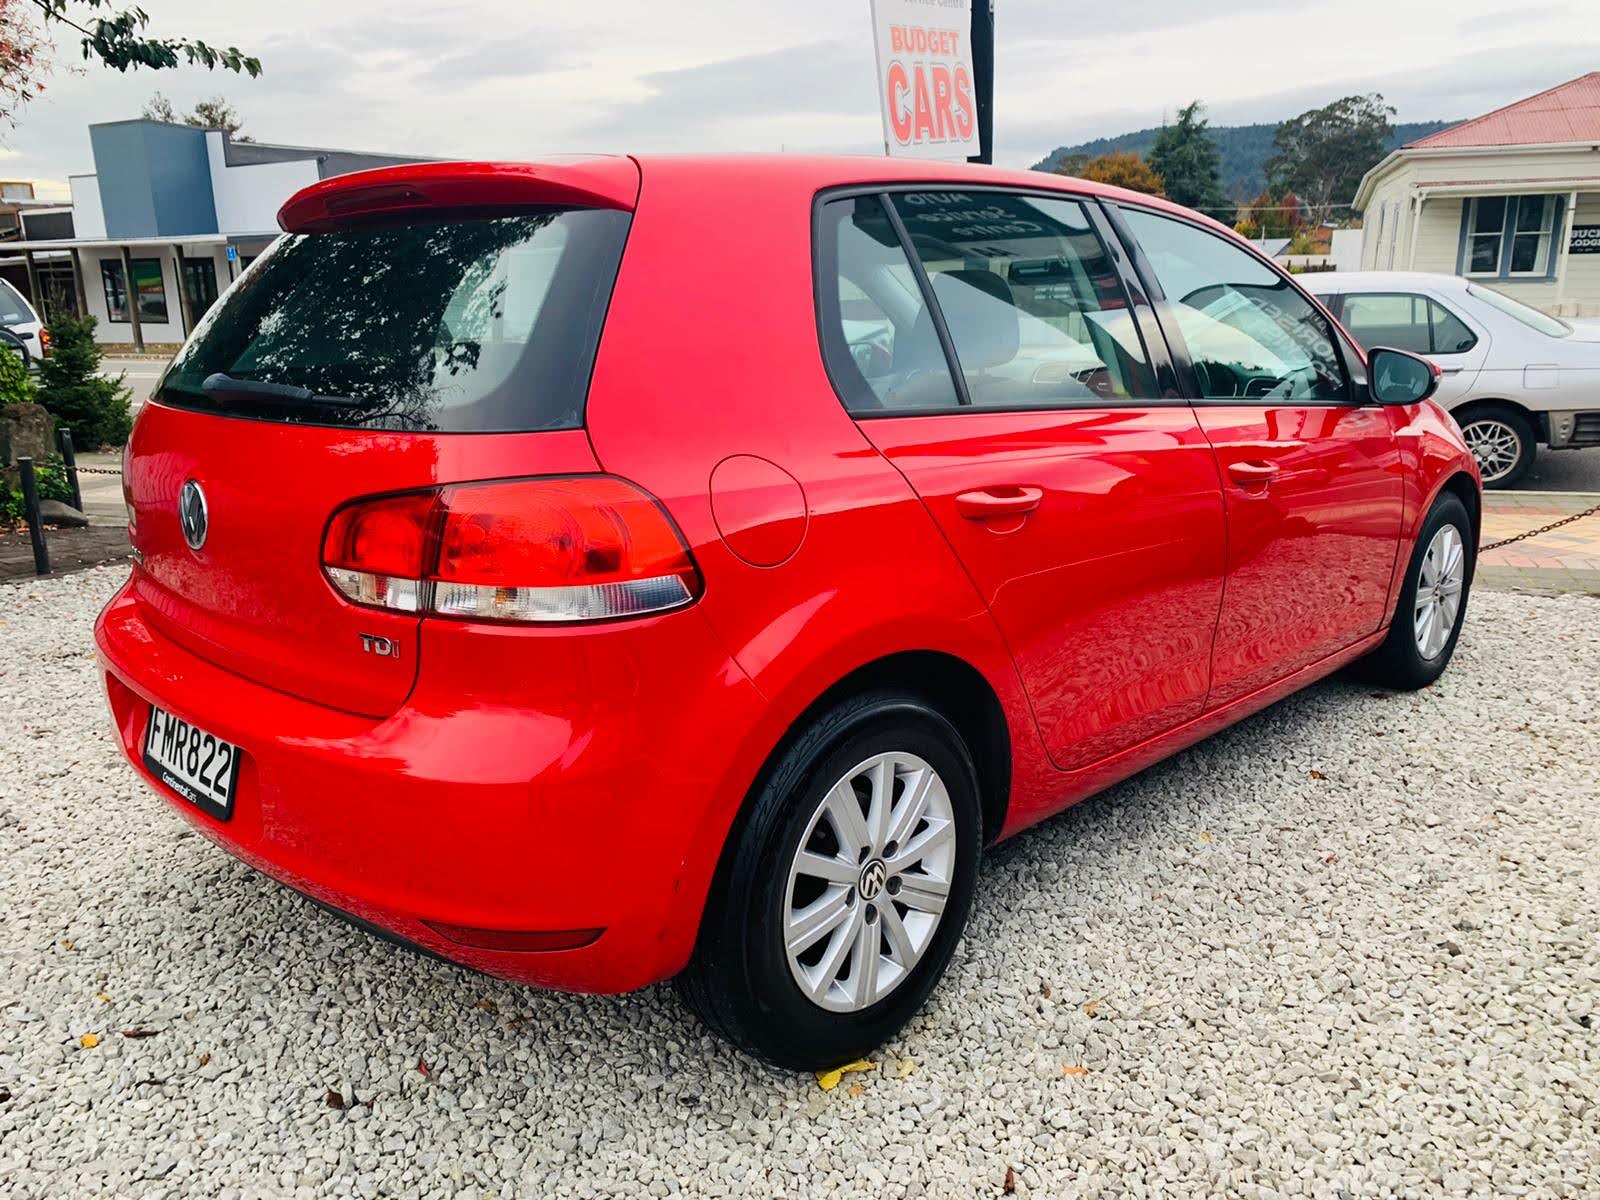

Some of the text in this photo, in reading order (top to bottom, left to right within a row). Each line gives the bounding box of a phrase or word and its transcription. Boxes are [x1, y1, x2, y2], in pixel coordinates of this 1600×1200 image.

[890, 25, 960, 56] BUDGET
[887, 61, 974, 145] CARS
[359, 632, 400, 659] TDI
[150, 706, 232, 798] FMR822
